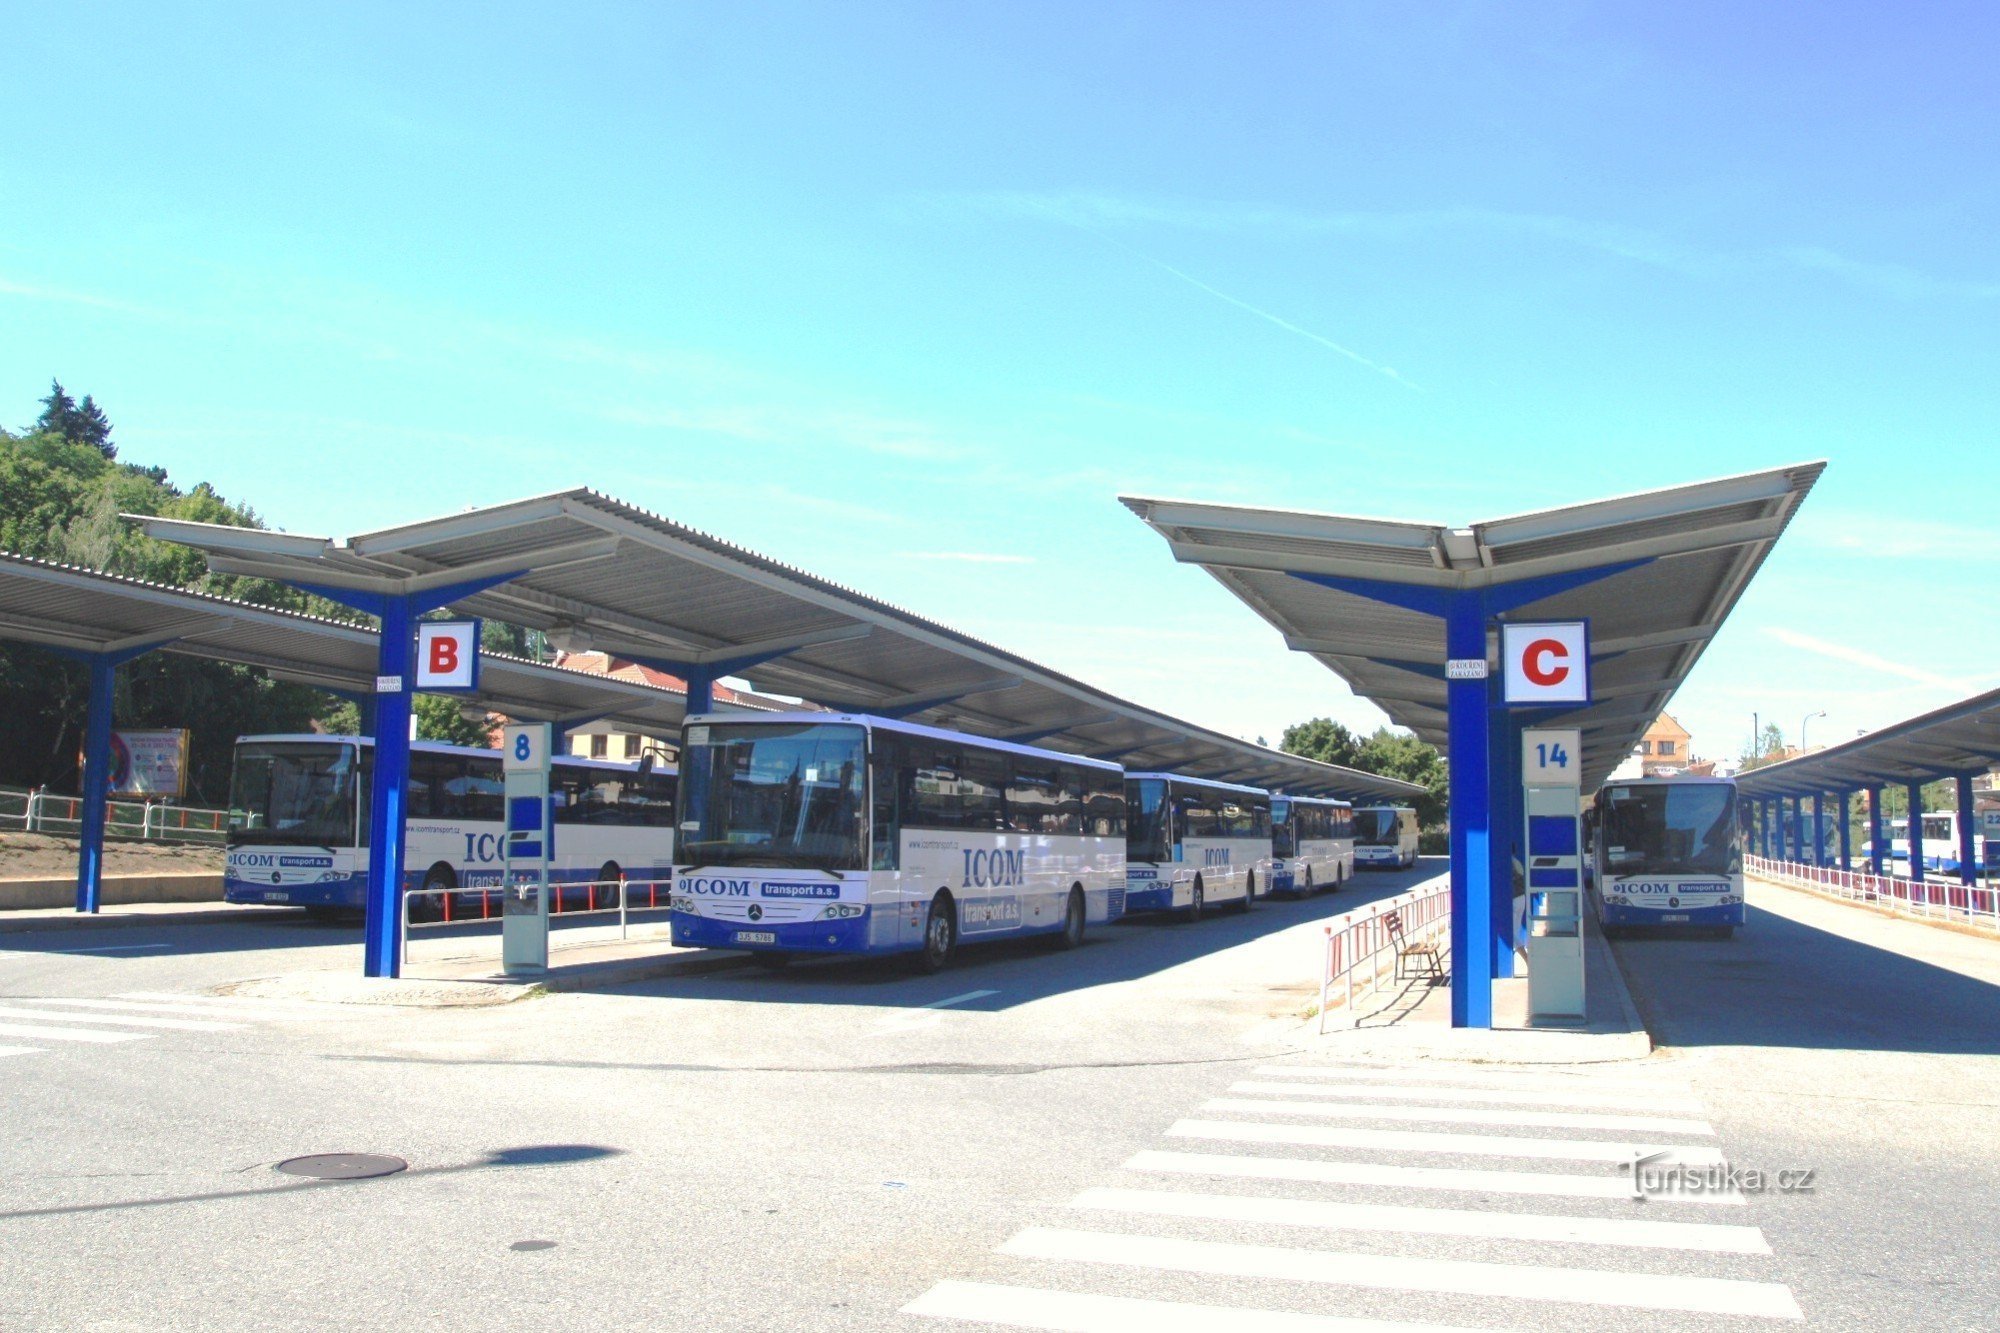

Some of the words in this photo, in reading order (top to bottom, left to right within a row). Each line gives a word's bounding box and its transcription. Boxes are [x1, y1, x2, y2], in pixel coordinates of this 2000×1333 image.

[429, 636, 458, 673] B
[1522, 639, 1569, 686] C
[515, 734, 530, 761] 8
[1536, 743, 1568, 768] 14
[232, 854, 274, 866] ICOM
[282, 857, 315, 866] transport
[316, 858, 330, 866] a.s.
[962, 849, 1025, 887] ICOM
[1205, 848, 1230, 866] ICOM
[687, 879, 750, 896] ICOM
[765, 885, 813, 896] transport
[816, 888, 836, 896] a.s.
[1620, 883, 1670, 894] ICOM
[1680, 884, 1715, 893] transport
[965, 901, 1005, 923] transport
[1006, 903, 1019, 919] a.s.
